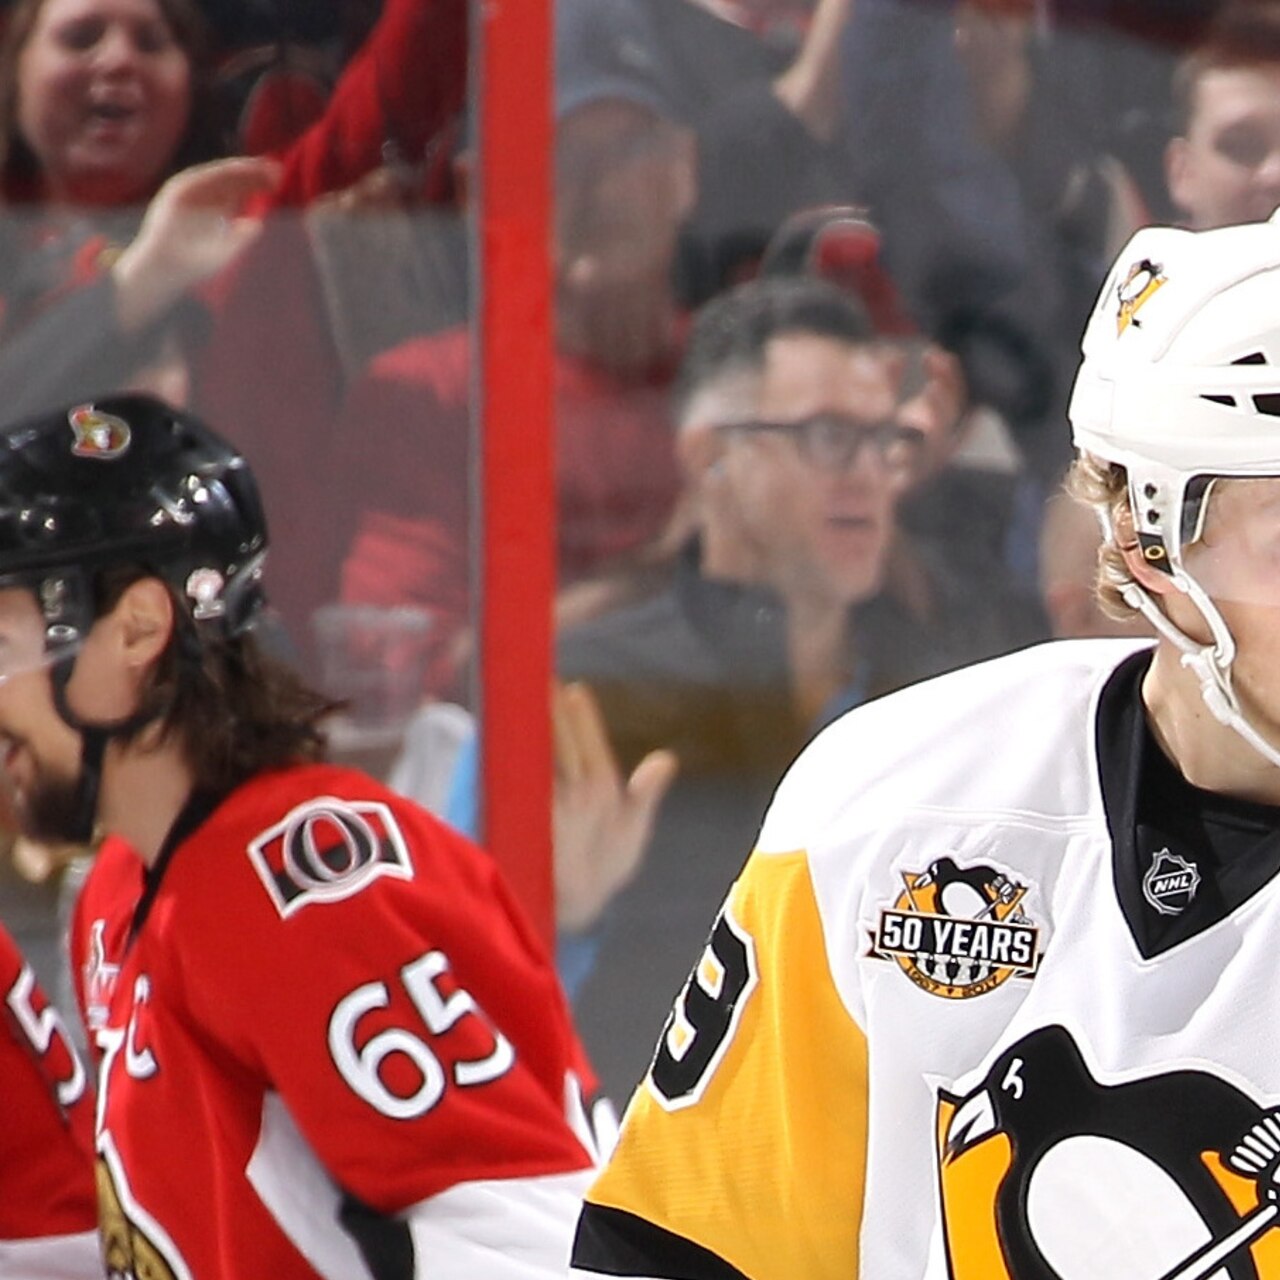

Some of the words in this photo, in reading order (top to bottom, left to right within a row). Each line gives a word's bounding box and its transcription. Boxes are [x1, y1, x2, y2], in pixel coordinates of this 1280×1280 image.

[1153, 875, 1189, 893] NHL
[882, 914, 923, 950] 50
[933, 920, 1033, 964] YEARS
[328, 950, 515, 1120] 65
